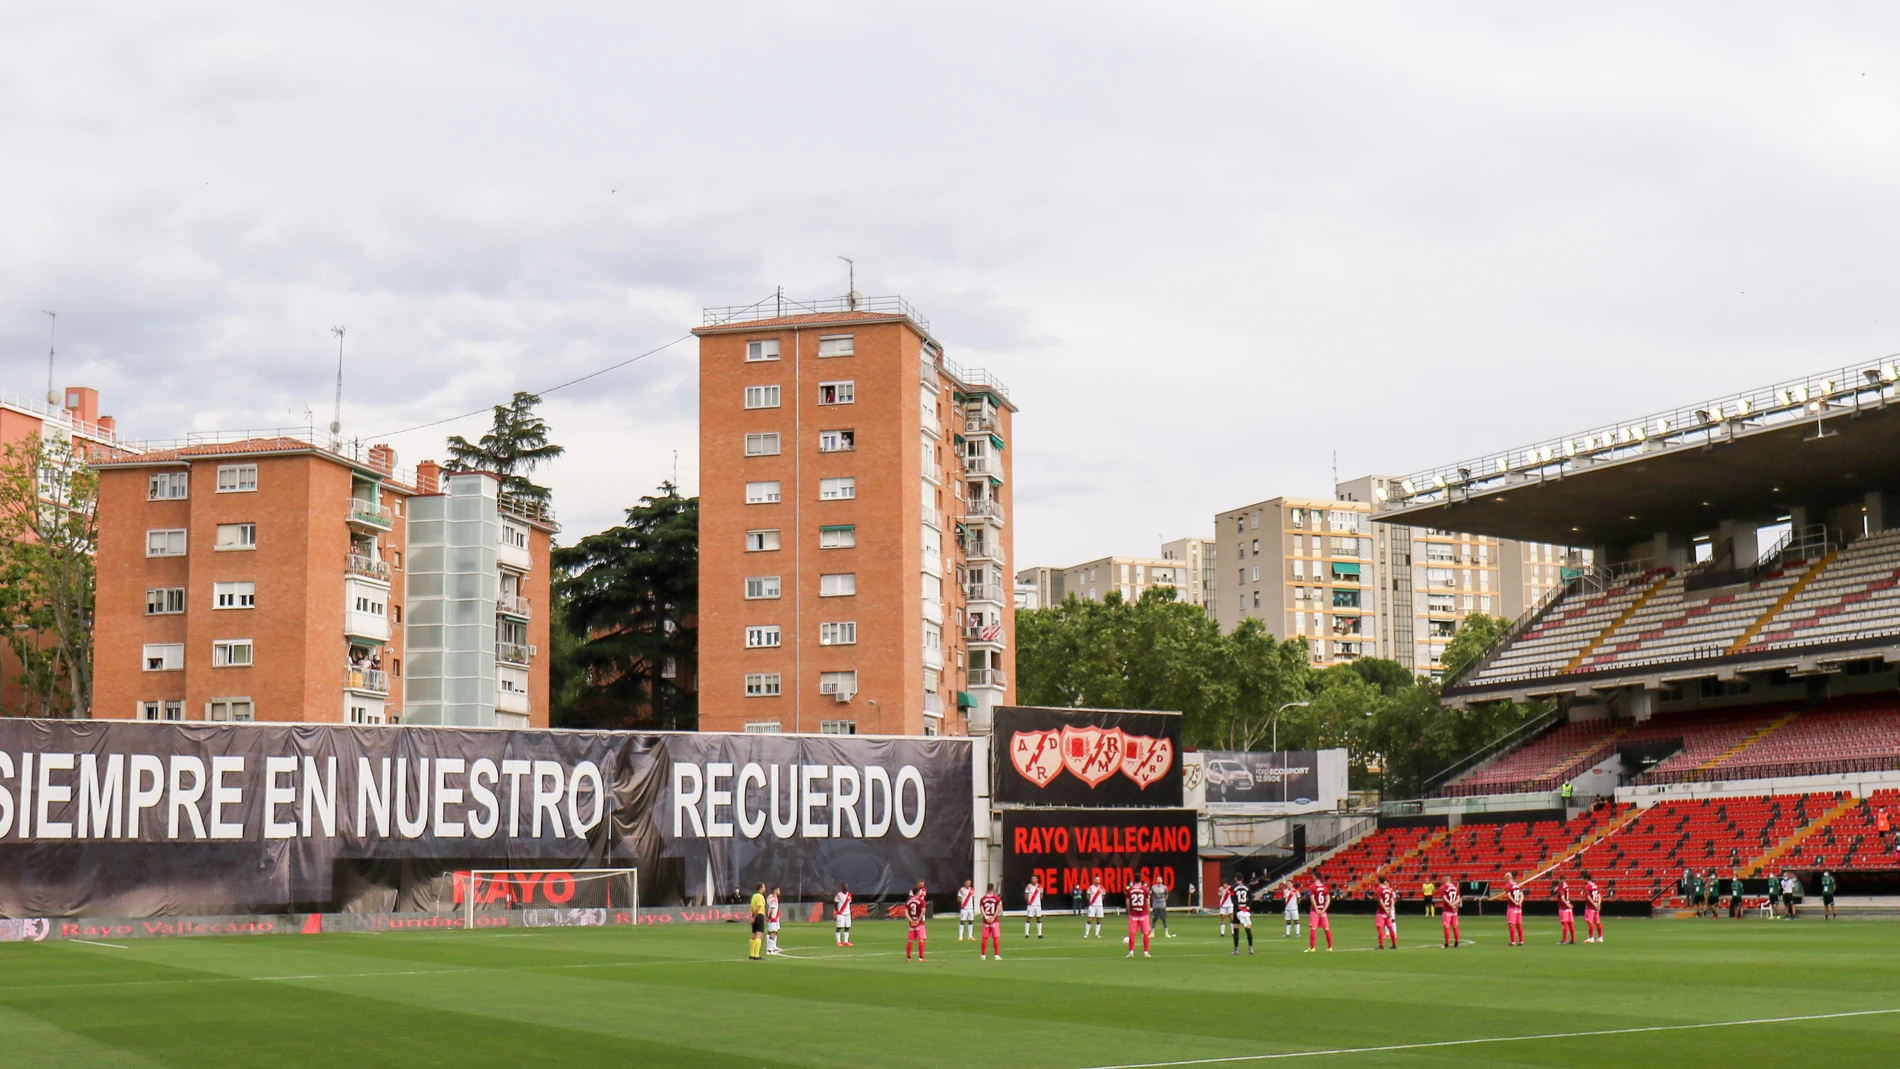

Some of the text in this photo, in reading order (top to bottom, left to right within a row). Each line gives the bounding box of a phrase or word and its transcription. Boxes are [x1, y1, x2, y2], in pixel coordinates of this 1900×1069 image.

[1018, 738, 1057, 752] A D
[1107, 737, 1119, 753] R
[1160, 743, 1167, 751] A
[1103, 751, 1116, 764] V
[1156, 754, 1163, 763] D
[1098, 760, 1110, 772] M
[1149, 764, 1156, 773] R
[1037, 766, 1047, 780] R
[264, 755, 337, 839] EN
[357, 757, 603, 839] NUESTRO
[674, 762, 926, 839] RECUERDO
[1014, 826, 1192, 854] RAYO VALLECANO
[453, 870, 576, 904] RAYO
[1033, 868, 1058, 895] DE
[1064, 867, 1135, 894] MADRID
[1131, 894, 1144, 906] 23
[1236, 890, 1247, 903] 13
[1318, 892, 1324, 904] 6
[1448, 891, 1457, 903] 17
[910, 903, 917, 915] 3
[985, 902, 995, 915] 21
[61, 923, 133, 937] Rayo
[143, 920, 273, 935] Vallecano
[372, 914, 508, 930] Fundacón
